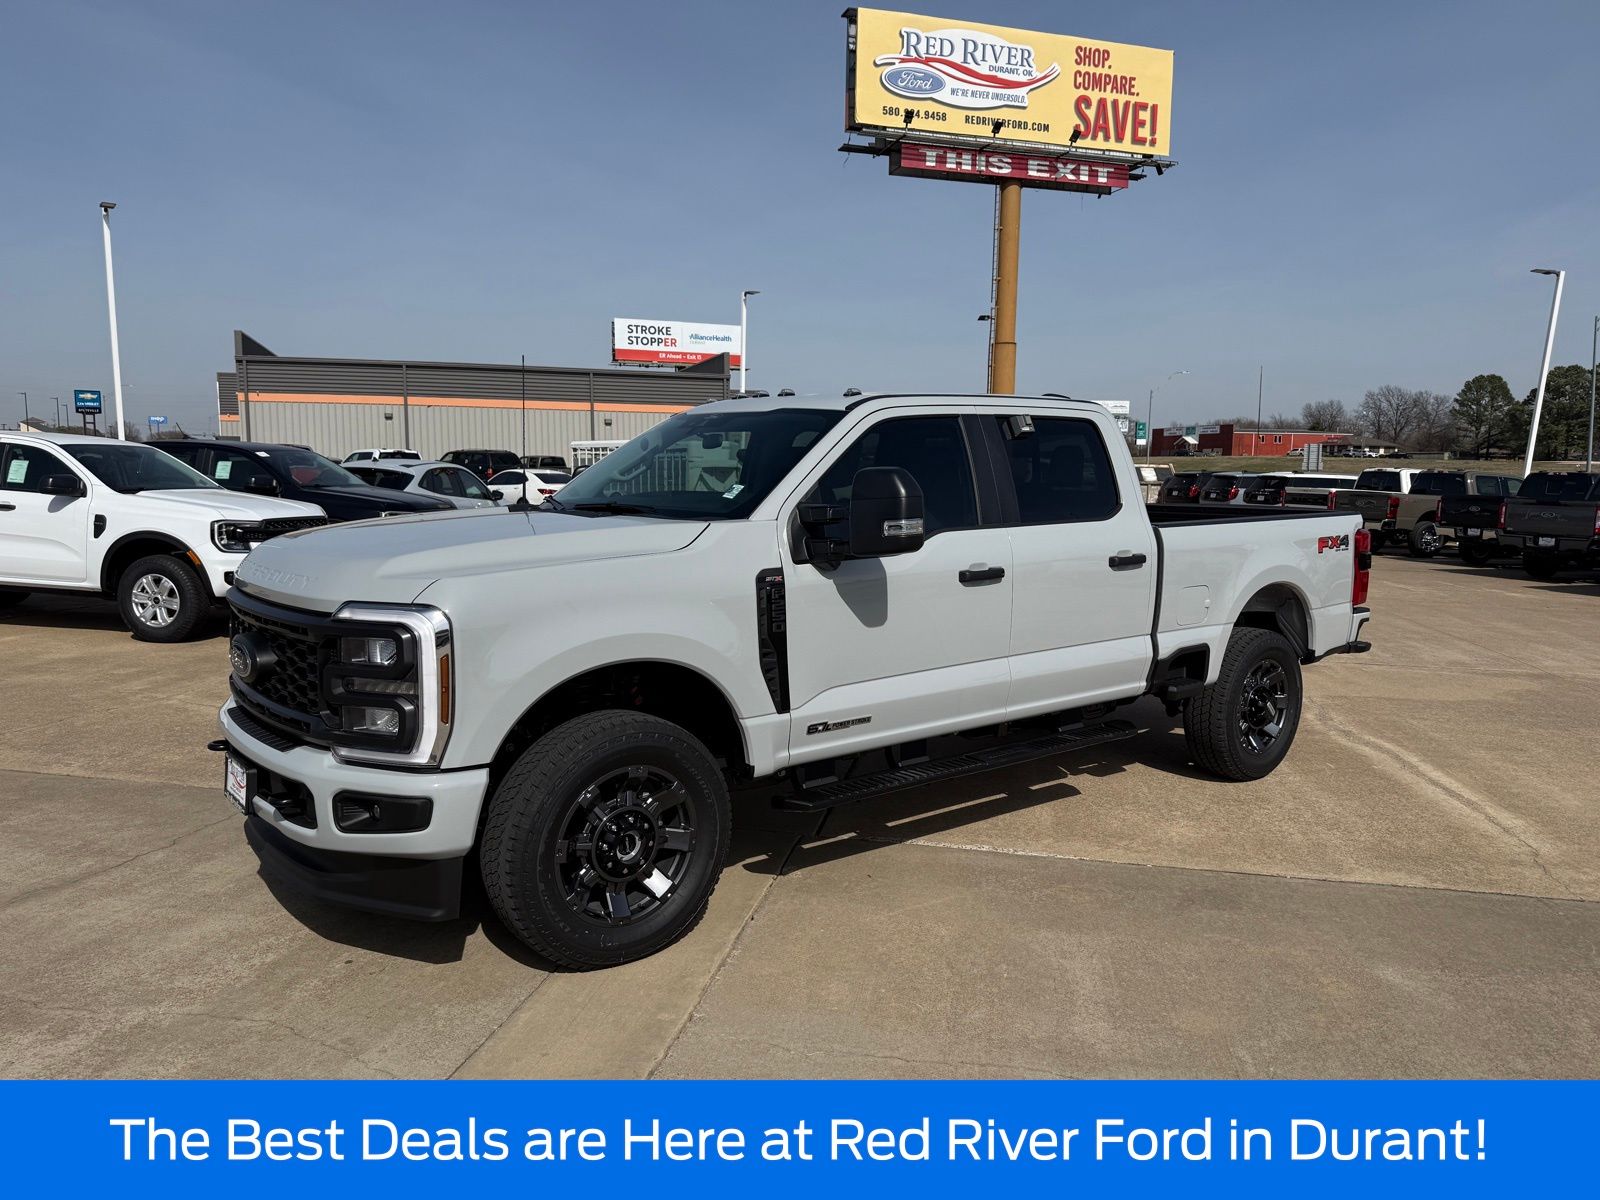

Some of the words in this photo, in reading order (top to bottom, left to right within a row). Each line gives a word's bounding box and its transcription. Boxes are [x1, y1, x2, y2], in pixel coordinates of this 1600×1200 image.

[903, 30, 955, 58] RED
[961, 38, 1034, 69] RIVER
[1074, 45, 1112, 70] SHOP.
[898, 70, 933, 90] Ford
[988, 64, 1021, 77] DURANT,
[1022, 69, 1034, 77] OK
[1073, 70, 1140, 97] COMPARE.
[950, 87, 970, 97] WE'RE
[970, 89, 990, 100] NEVER
[991, 91, 1027, 104] UNDERSOLD.
[882, 105, 947, 122] 580.4.9458
[1073, 95, 1158, 147] SAVE!
[919, 149, 1012, 174] THIS
[1027, 159, 1114, 183] EXIT
[627, 324, 672, 336] STROKE
[689, 333, 732, 343] AllianceHealth
[627, 336, 677, 348] STOPPER
[1318, 534, 1349, 554] FX4
